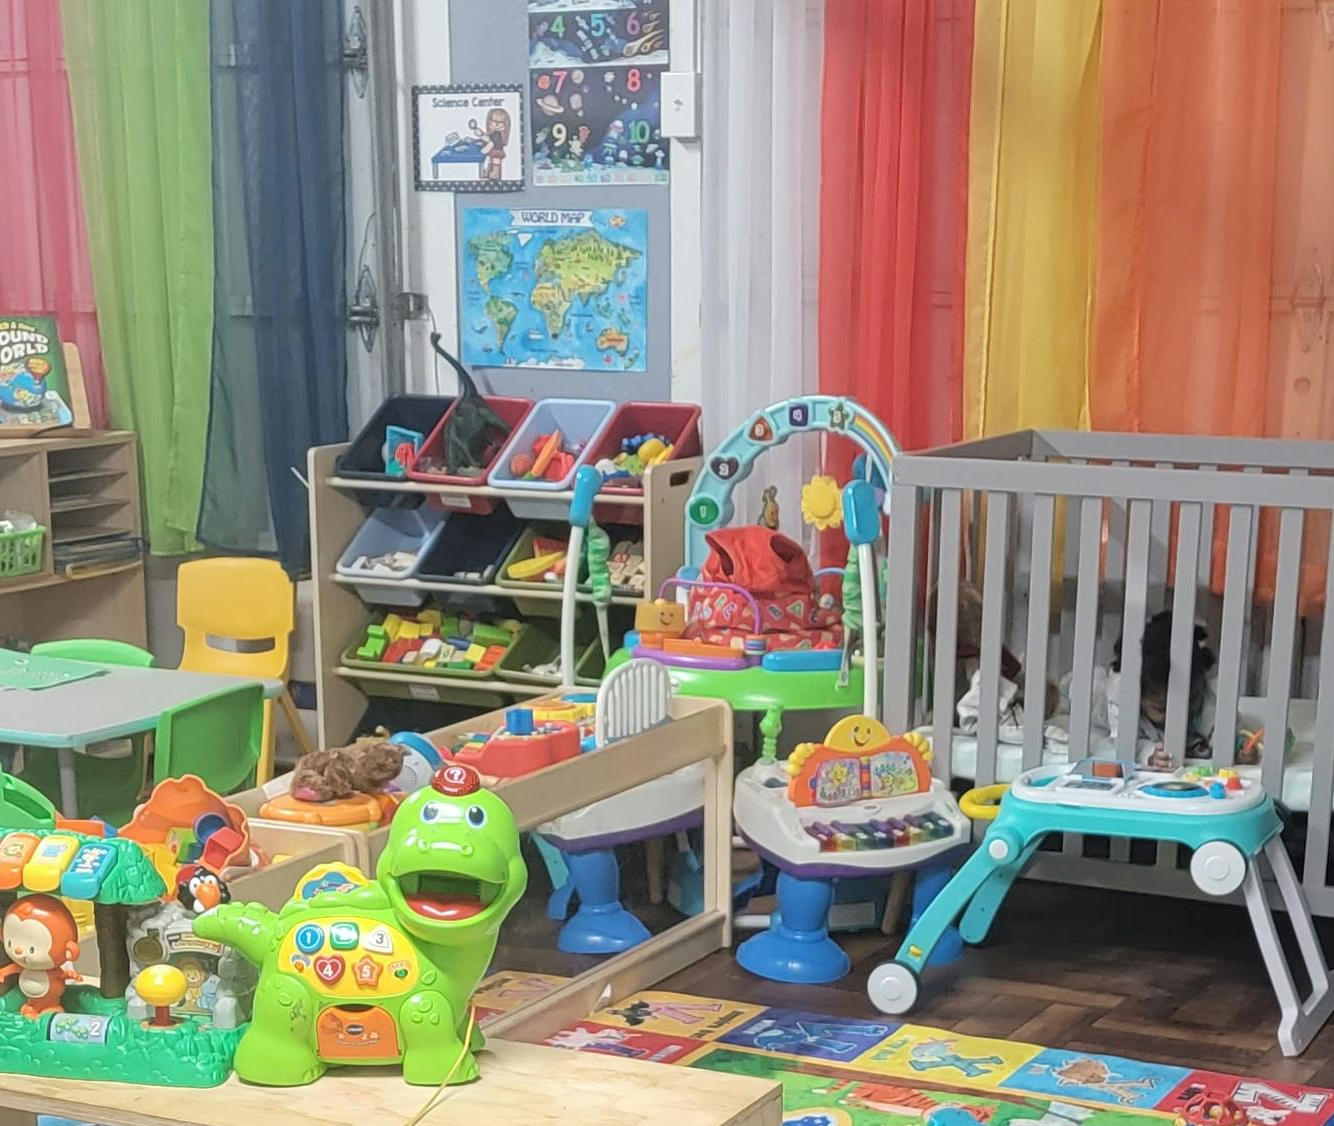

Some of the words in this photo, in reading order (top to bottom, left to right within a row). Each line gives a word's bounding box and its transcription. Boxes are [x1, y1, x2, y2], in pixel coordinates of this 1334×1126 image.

[550, 16, 566, 38] 4
[591, 14, 607, 37] 5
[626, 14, 641, 36] 6
[552, 71, 568, 94] 7
[626, 68, 642, 92] 8
[432, 97, 469, 109] Science
[471, 96, 505, 108] Center
[551, 123, 568, 147] 9
[628, 120, 651, 144] 10
[521, 211, 559, 224] WORLD
[561, 212, 585, 224] MAP
[89, 1020, 101, 1037] 2
